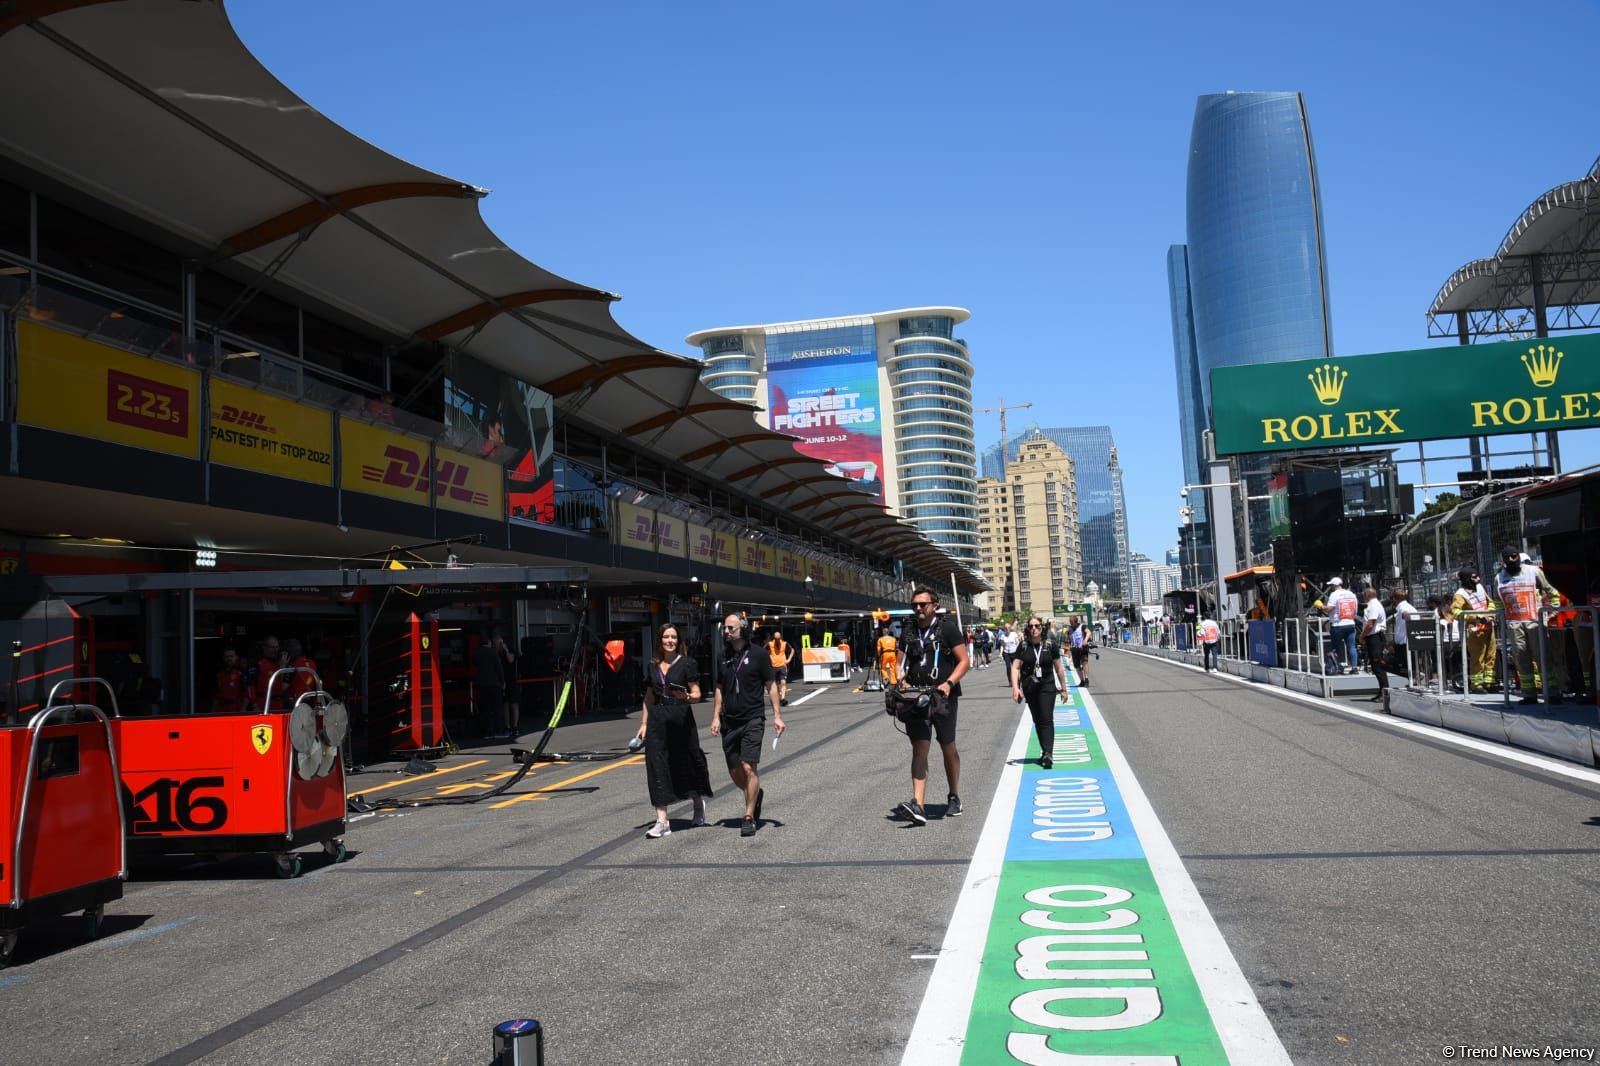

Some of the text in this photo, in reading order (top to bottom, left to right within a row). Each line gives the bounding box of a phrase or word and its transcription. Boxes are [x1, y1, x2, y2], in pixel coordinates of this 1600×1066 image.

[791, 345, 851, 359] ABSHERON
[117, 384, 181, 424] 2.23s
[221, 405, 268, 431] DHL
[775, 408, 875, 430] FIGHTERS
[788, 393, 860, 413] STREET
[1261, 409, 1404, 443] ROLEX
[211, 427, 330, 464] FASTEST PIT STOP 2022
[382, 445, 475, 502] DHL
[634, 515, 673, 547] DHL
[699, 534, 728, 560] DHL
[135, 776, 228, 832] 16
[1031, 777, 1114, 842] aramco
